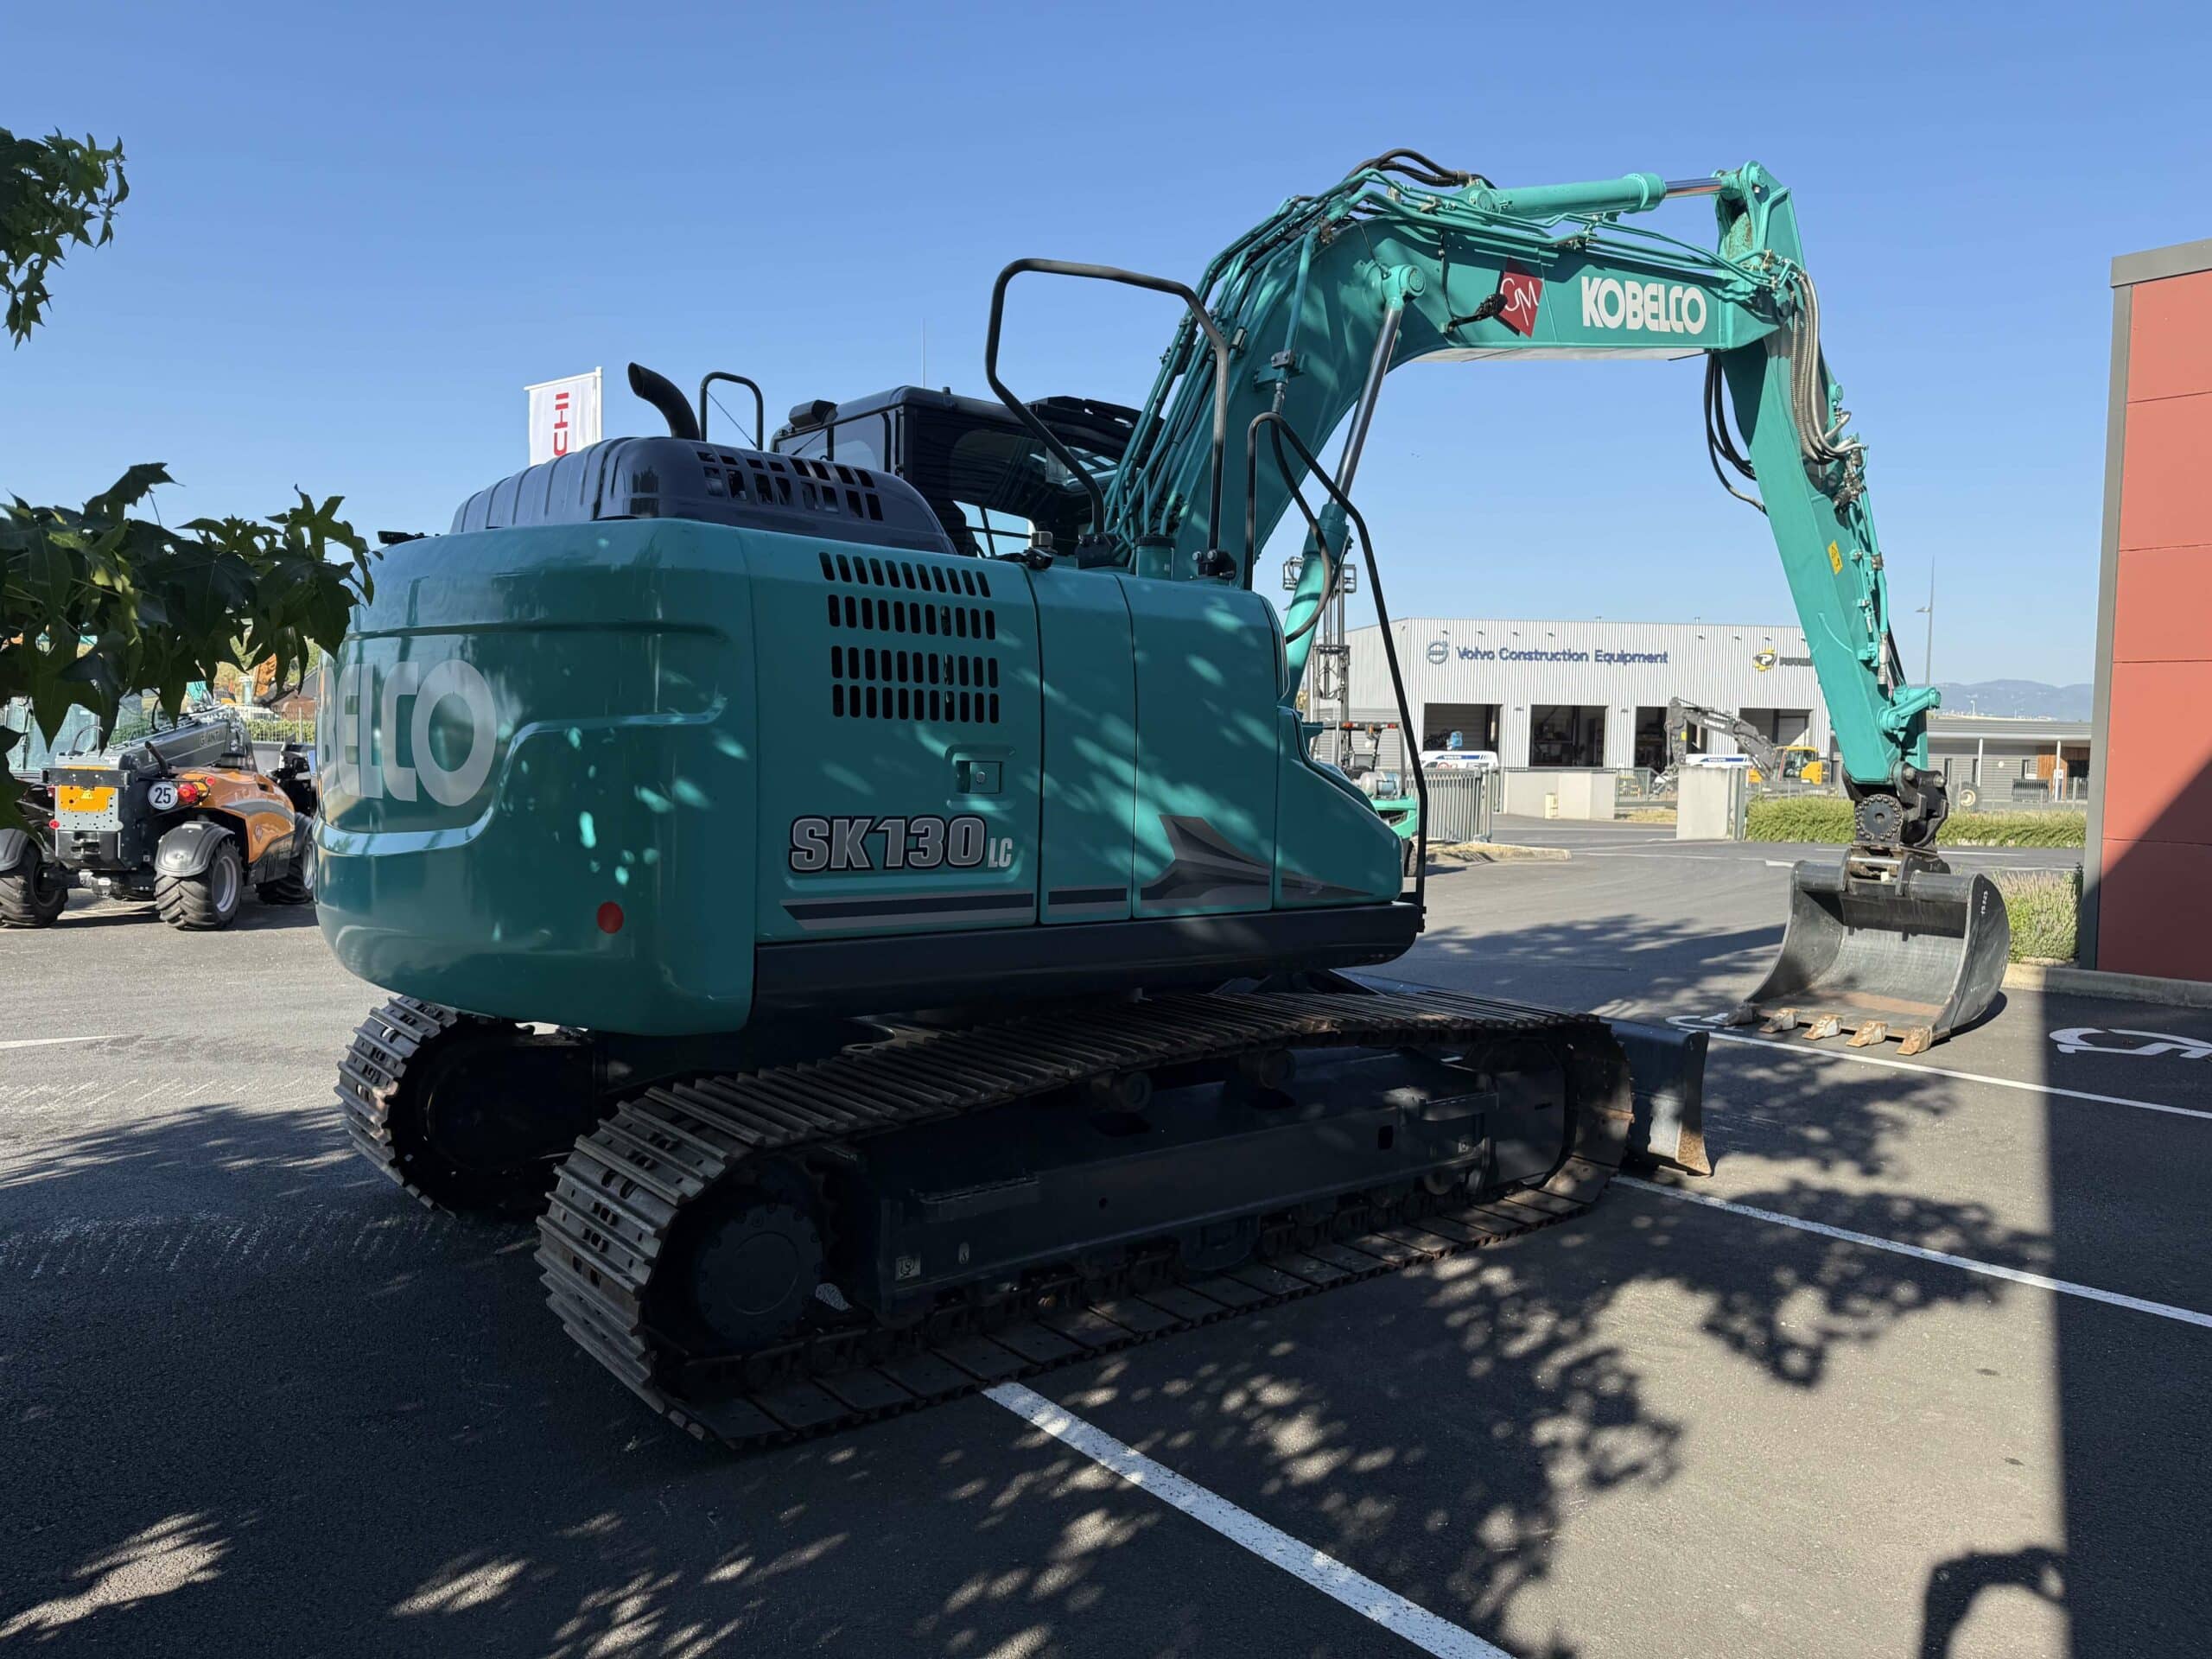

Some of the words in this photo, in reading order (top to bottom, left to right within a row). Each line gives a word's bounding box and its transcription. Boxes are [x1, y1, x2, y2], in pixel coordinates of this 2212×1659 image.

[1580, 275, 1707, 335] KOBELCO
[553, 391, 569, 456] CHI
[1455, 646, 1496, 661] Volvo
[1498, 646, 1590, 663] Construction
[1594, 649, 1669, 666] Equipment
[154, 786, 172, 804] 25
[789, 815, 987, 872] SK130
[987, 837, 1014, 868] LC
